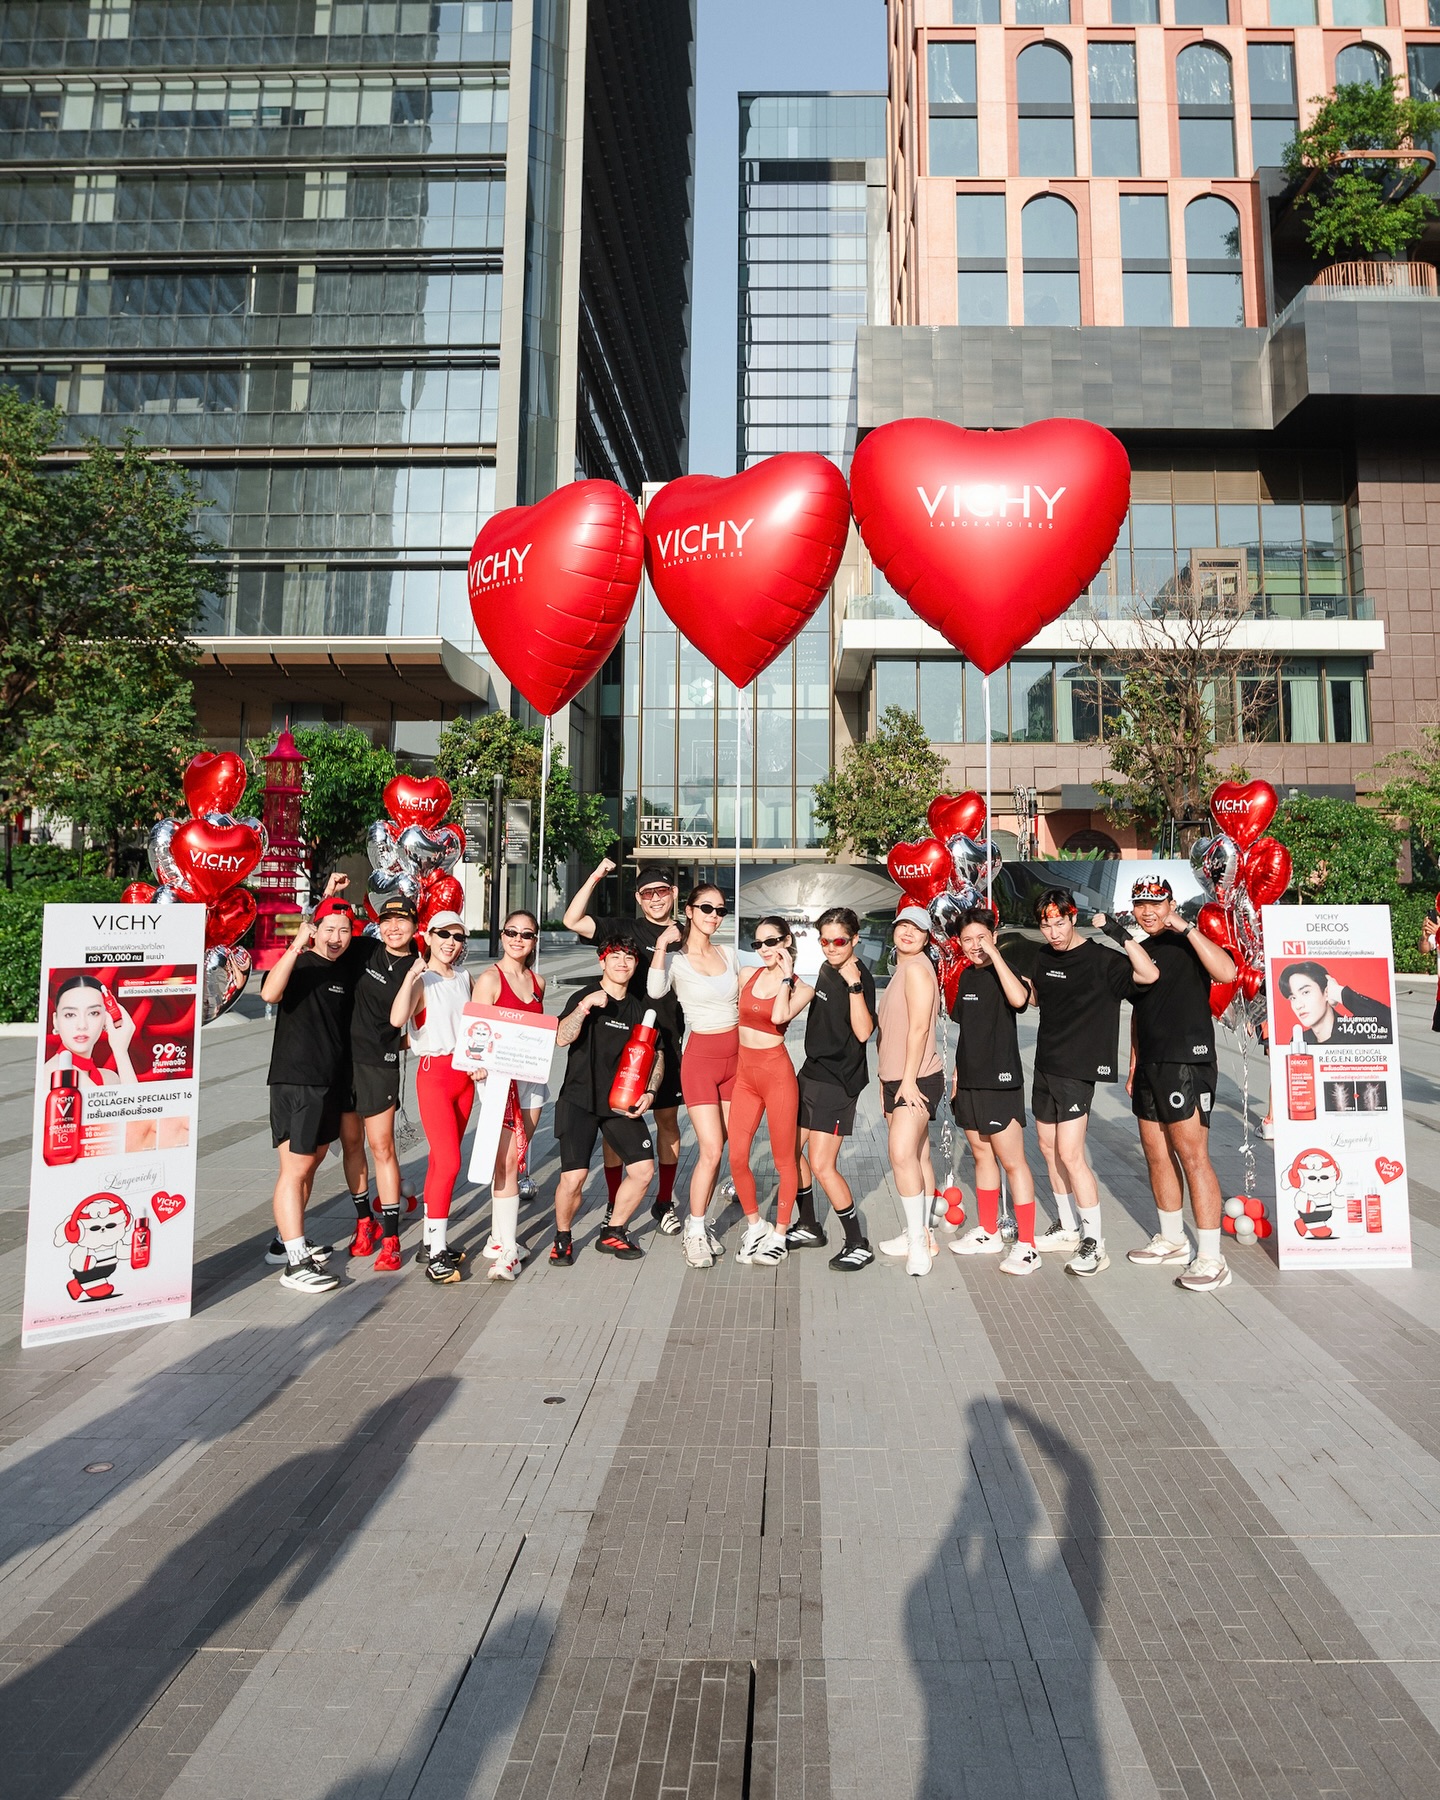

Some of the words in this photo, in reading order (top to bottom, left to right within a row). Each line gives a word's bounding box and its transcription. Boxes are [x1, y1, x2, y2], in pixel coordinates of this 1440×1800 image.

[916, 484, 1067, 519] VICHY
[929, 521, 1053, 529] LABORATOIRES
[657, 518, 755, 560] VICHY
[470, 543, 533, 590] VICHY
[663, 551, 743, 569] LABORATOIRES
[397, 795, 439, 809] VICHY
[1215, 799, 1253, 811] VICHY
[640, 818, 673, 831] THE
[640, 833, 708, 847] STOREYS
[189, 849, 245, 870] VICHY
[894, 862, 934, 876] VICHY
[92, 914, 162, 930] VICHY
[1306, 922, 1350, 933] DERCOS
[88, 954, 101, 963] กว่า
[102, 952, 132, 963] 70,000
[498, 1009, 525, 1020] VICHY
[1337, 1023, 1378, 1036] +14,000
[628, 1047, 646, 1055] VICHY
[87, 1097, 135, 1108] COLLAGEN
[137, 1092, 181, 1104] SPECIALIST
[183, 1091, 193, 1099] 16
[88, 1091, 118, 1099] LIFTACTIV
[87, 1105, 163, 1119] เซรั่มลดเลือนริ้วรอย
[57, 1133, 69, 1143] 16
[1379, 1160, 1400, 1173] VICHY
[156, 1196, 182, 1208] VICHY
